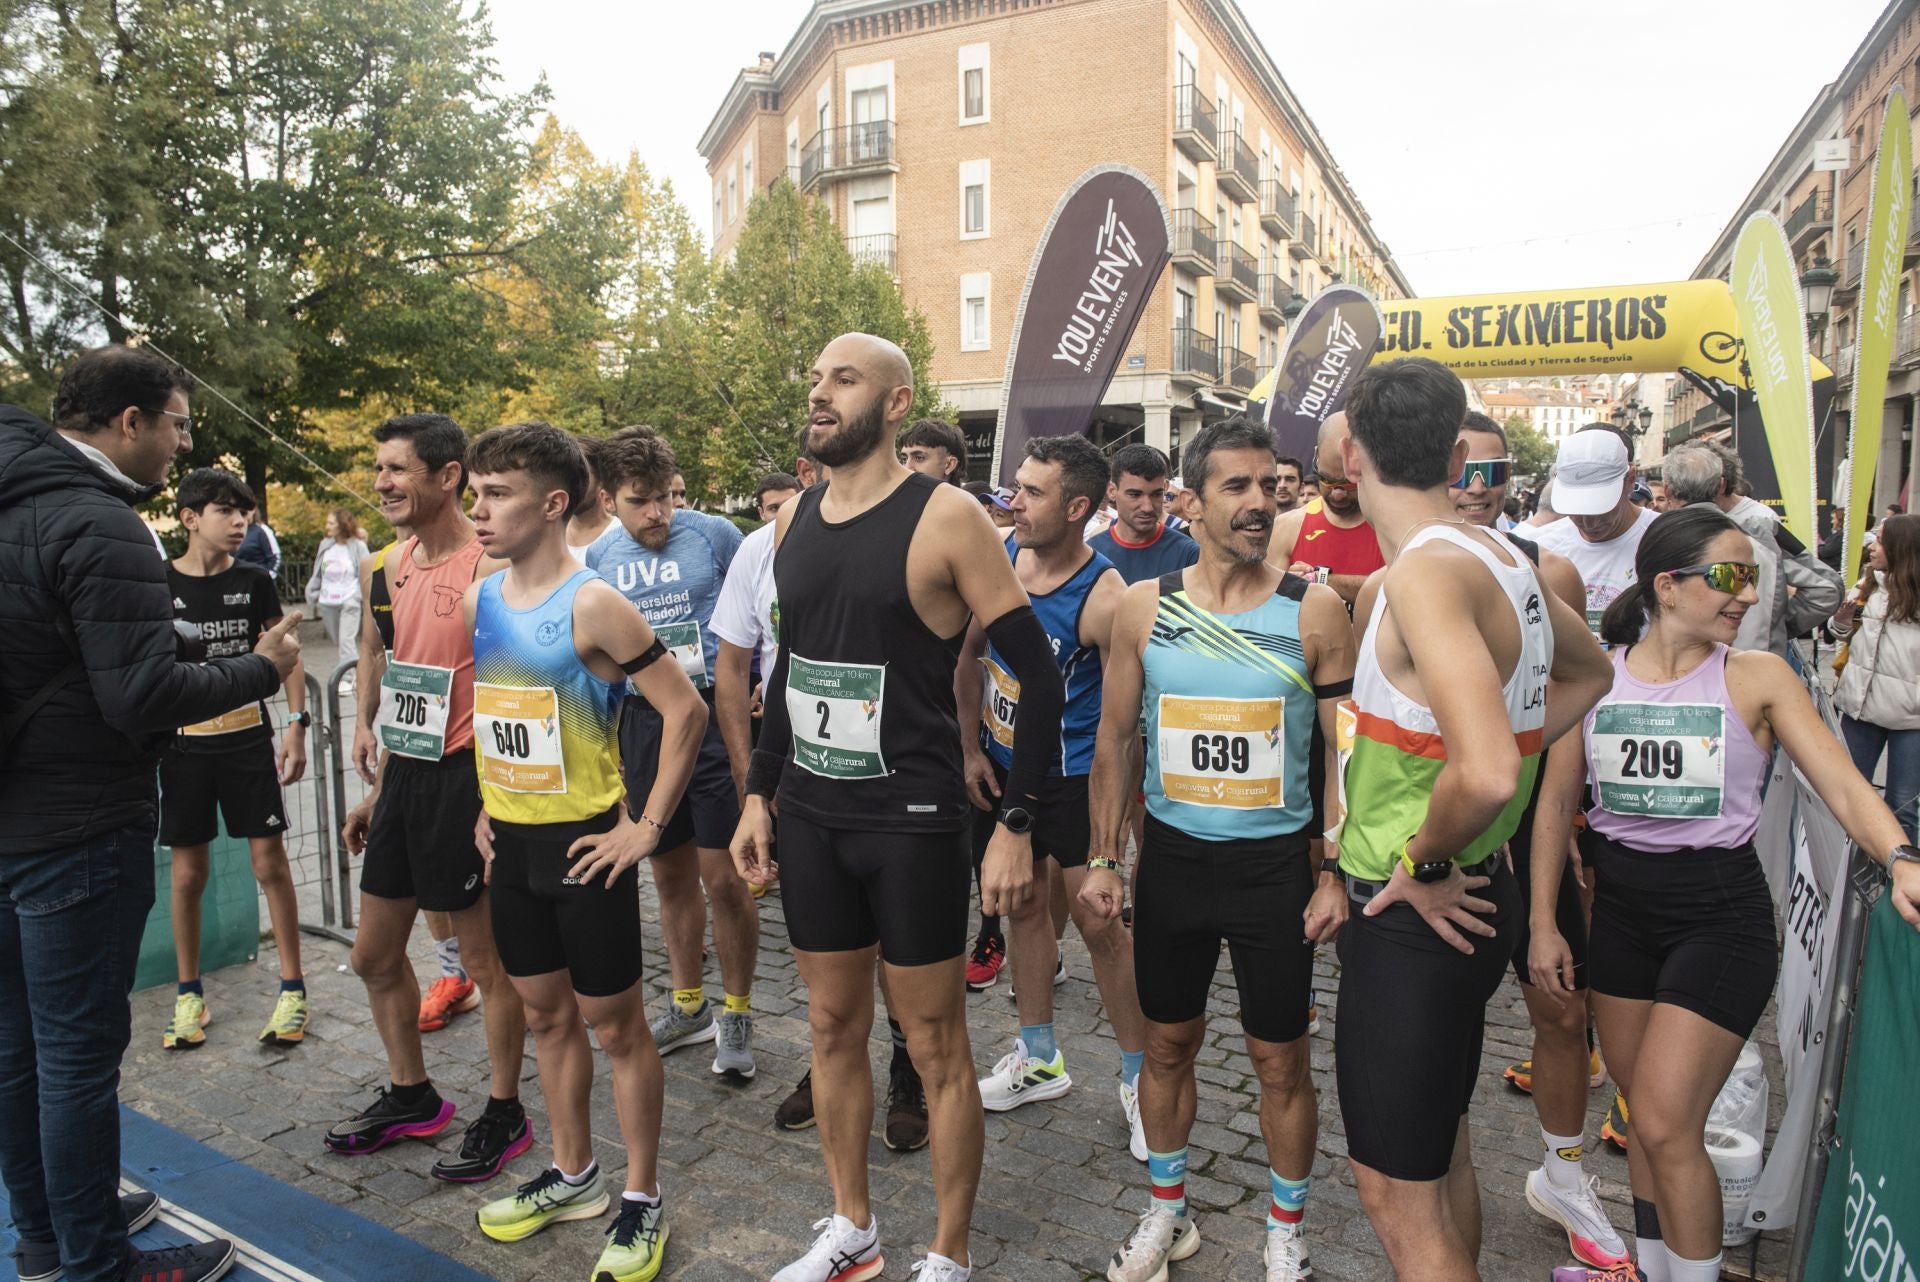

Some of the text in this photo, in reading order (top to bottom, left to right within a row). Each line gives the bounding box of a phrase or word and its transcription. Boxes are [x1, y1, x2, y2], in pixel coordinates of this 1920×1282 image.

[1443, 295, 1668, 350] SEXMEROS
[1084, 291, 1129, 374] SPORTS SERVICES
[1463, 360, 1476, 368] de
[1478, 359, 1488, 367] la
[1490, 357, 1527, 367] Ciudad
[1529, 359, 1536, 367] y
[1538, 356, 1571, 365] Tierra
[1573, 355, 1587, 363] de
[1589, 354, 1633, 364] Segovia
[1318, 366, 1351, 422] SPORTS SERVICES
[617, 557, 681, 592] UVa
[815, 669, 845, 679] popular
[847, 670, 857, 679] 10
[806, 676, 840, 688] cajarural
[800, 684, 818, 694] CONTRA
[395, 692, 428, 727] 206
[1644, 708, 1680, 717] popular
[1682, 708, 1694, 716] 10
[816, 700, 831, 740] 2
[1199, 711, 1241, 722] cajarural
[1629, 717, 1675, 727] cajarural
[1614, 726, 1646, 734] CONTRA
[1647, 727, 1656, 735] EL
[492, 720, 530, 758] 640
[1191, 734, 1250, 774] 639
[1620, 738, 1683, 780] 209
[829, 755, 867, 767] cajarural
[1226, 785, 1268, 796] cajarural
[1608, 791, 1640, 801] cajaviva
[1657, 794, 1705, 804] cajarural
